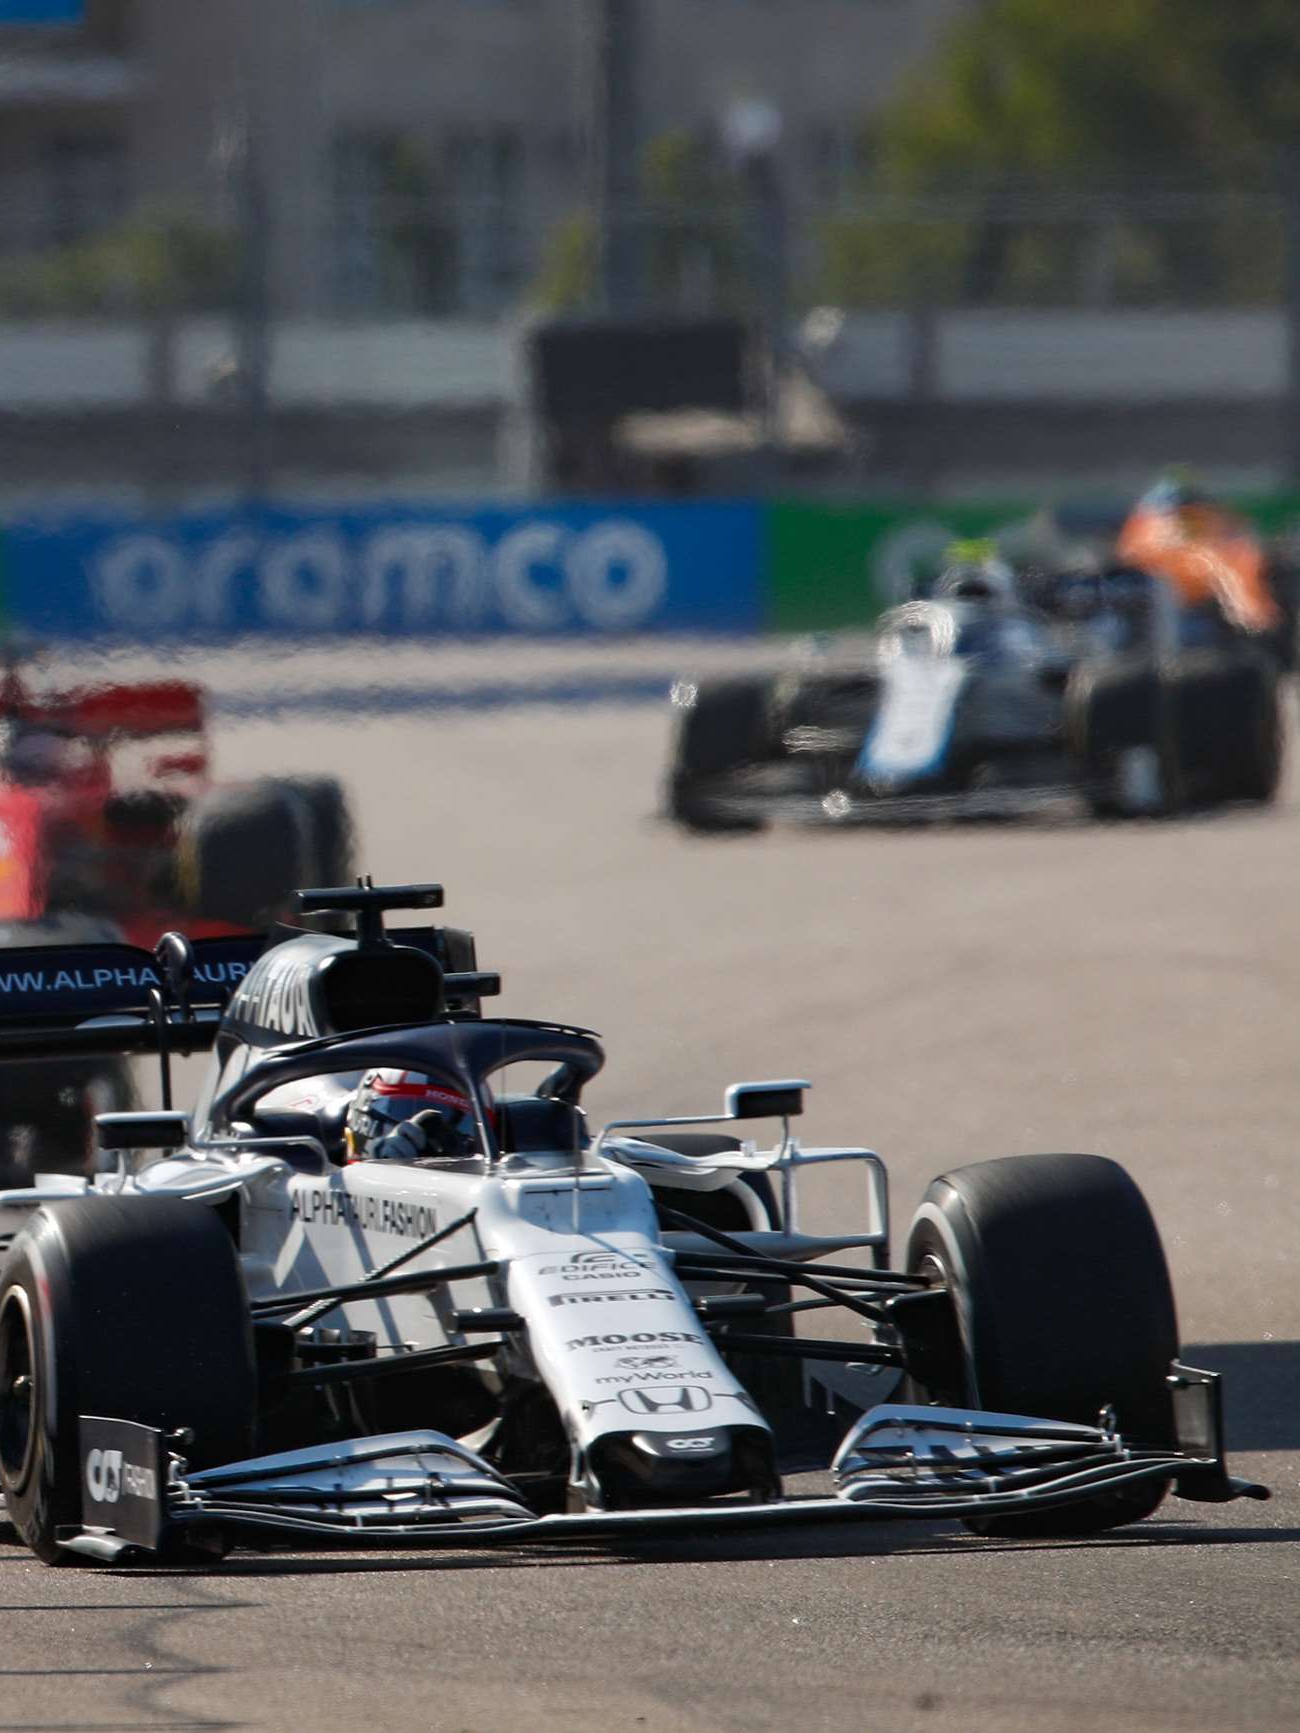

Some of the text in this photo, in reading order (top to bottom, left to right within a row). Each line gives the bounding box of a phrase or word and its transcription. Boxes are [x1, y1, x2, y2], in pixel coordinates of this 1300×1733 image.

[85, 518, 668, 632] aramco
[562, 1271, 641, 1281] CASIO
[548, 1289, 676, 1307] PIRELLI
[565, 1331, 704, 1352] MOOSE
[595, 1370, 713, 1385] myWorld
